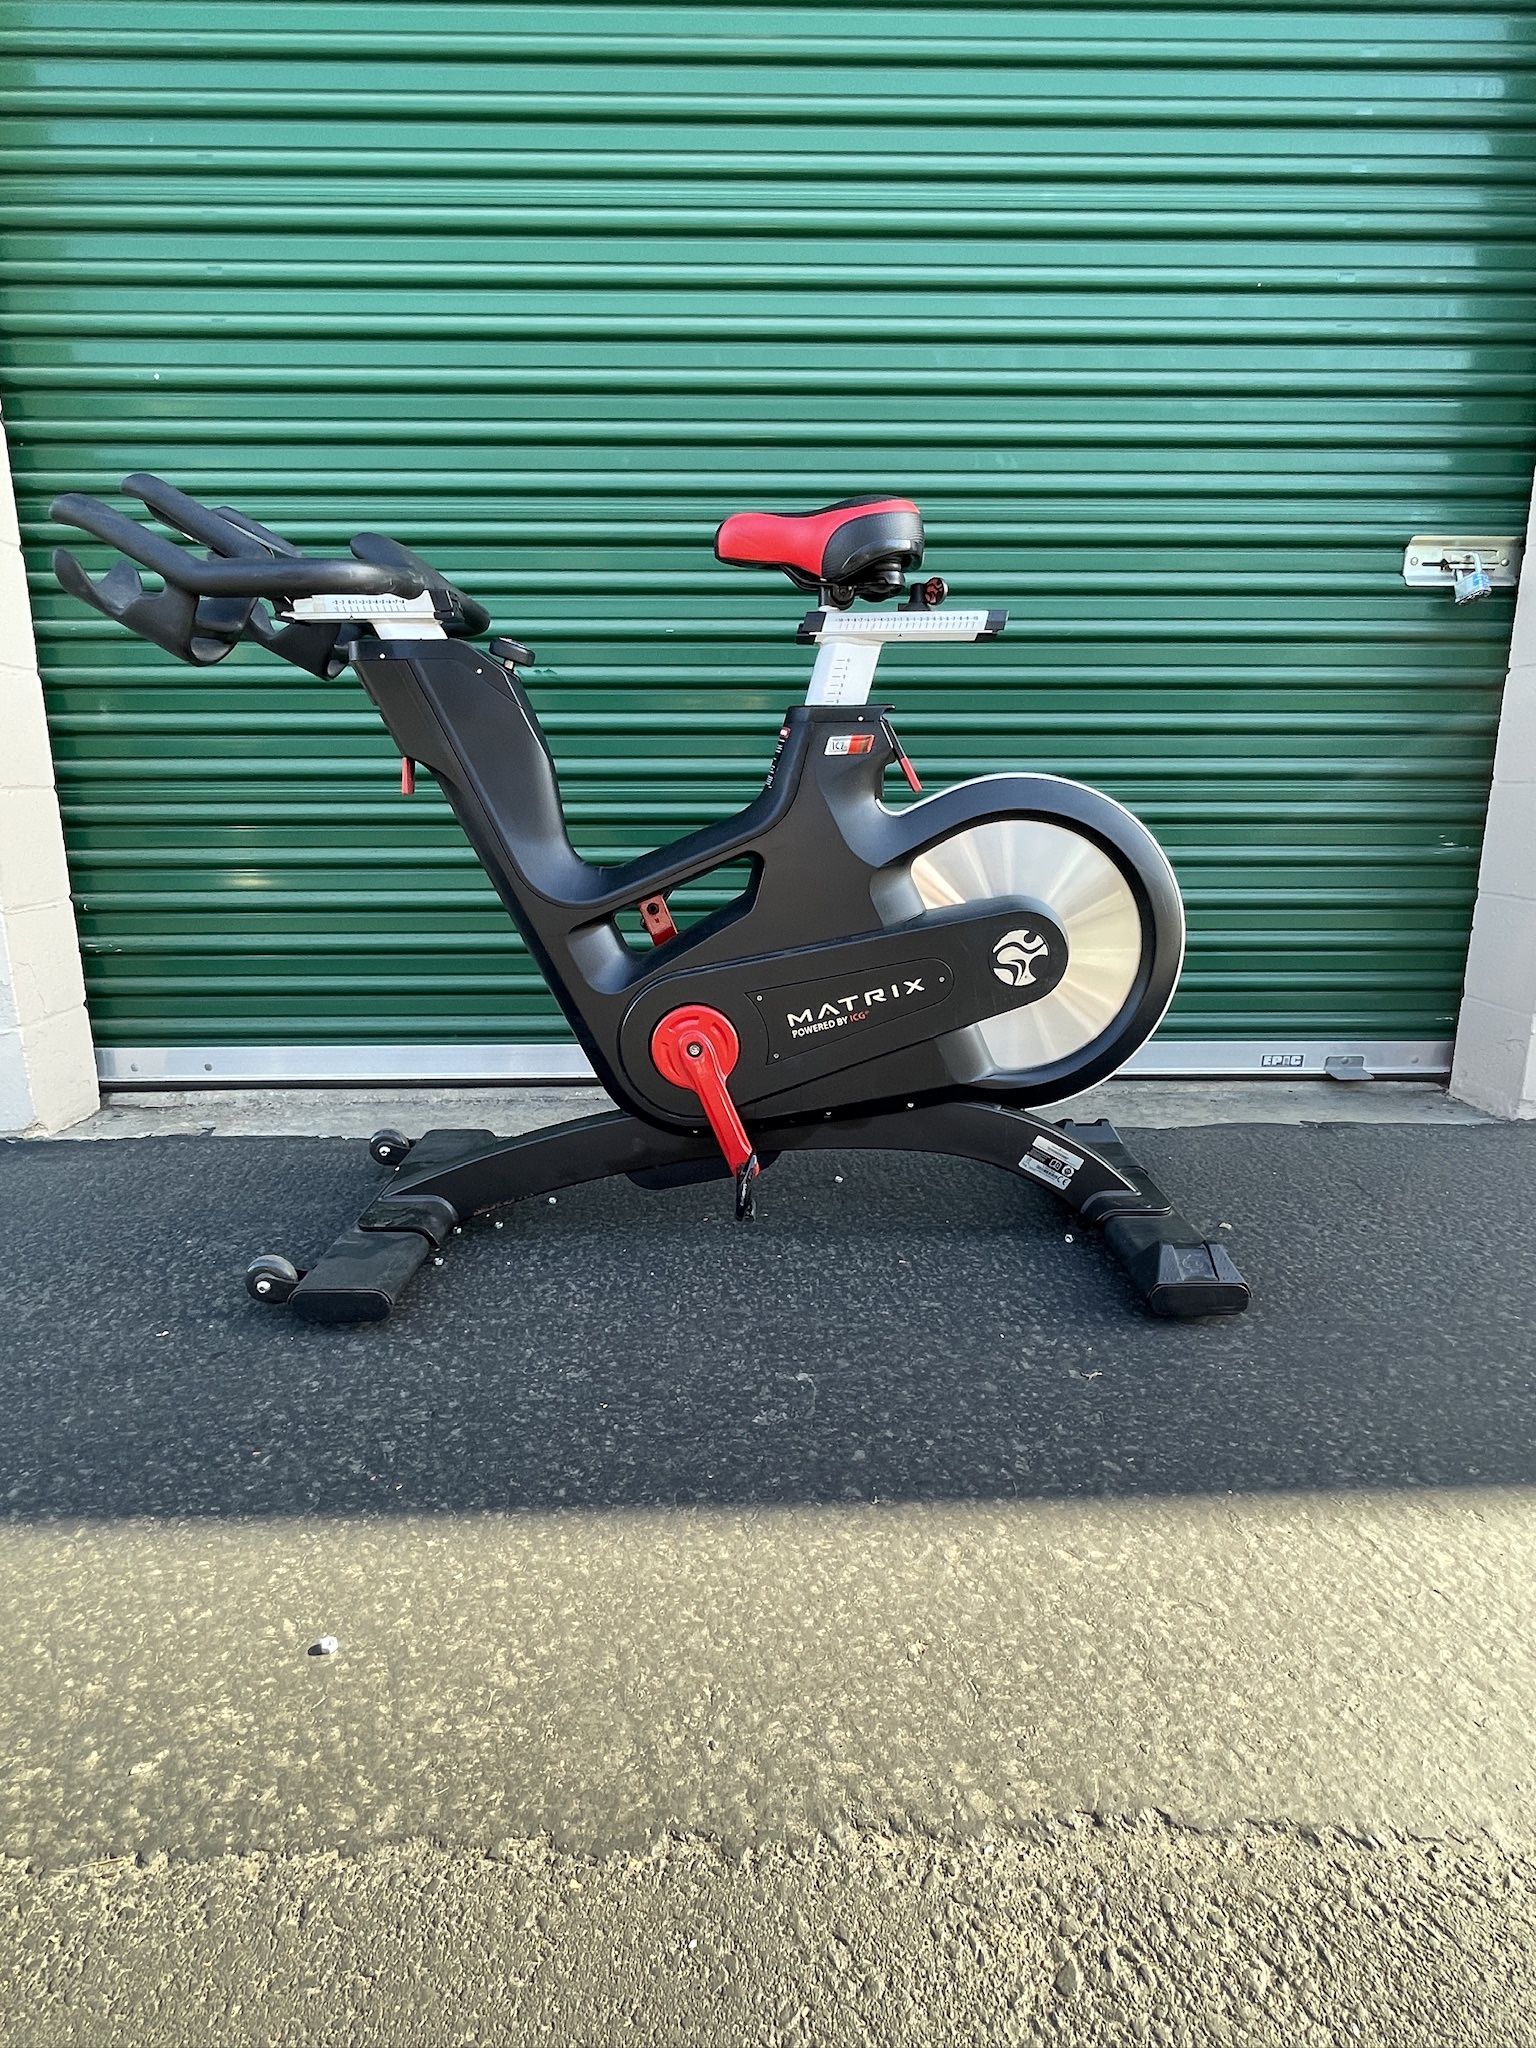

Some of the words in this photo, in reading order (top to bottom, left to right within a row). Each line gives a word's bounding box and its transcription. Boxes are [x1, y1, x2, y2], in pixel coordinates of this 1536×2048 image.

[786, 977, 926, 1028] MATRIX
[791, 1019, 836, 1039] POWERED
[836, 1015, 849, 1028] BY
